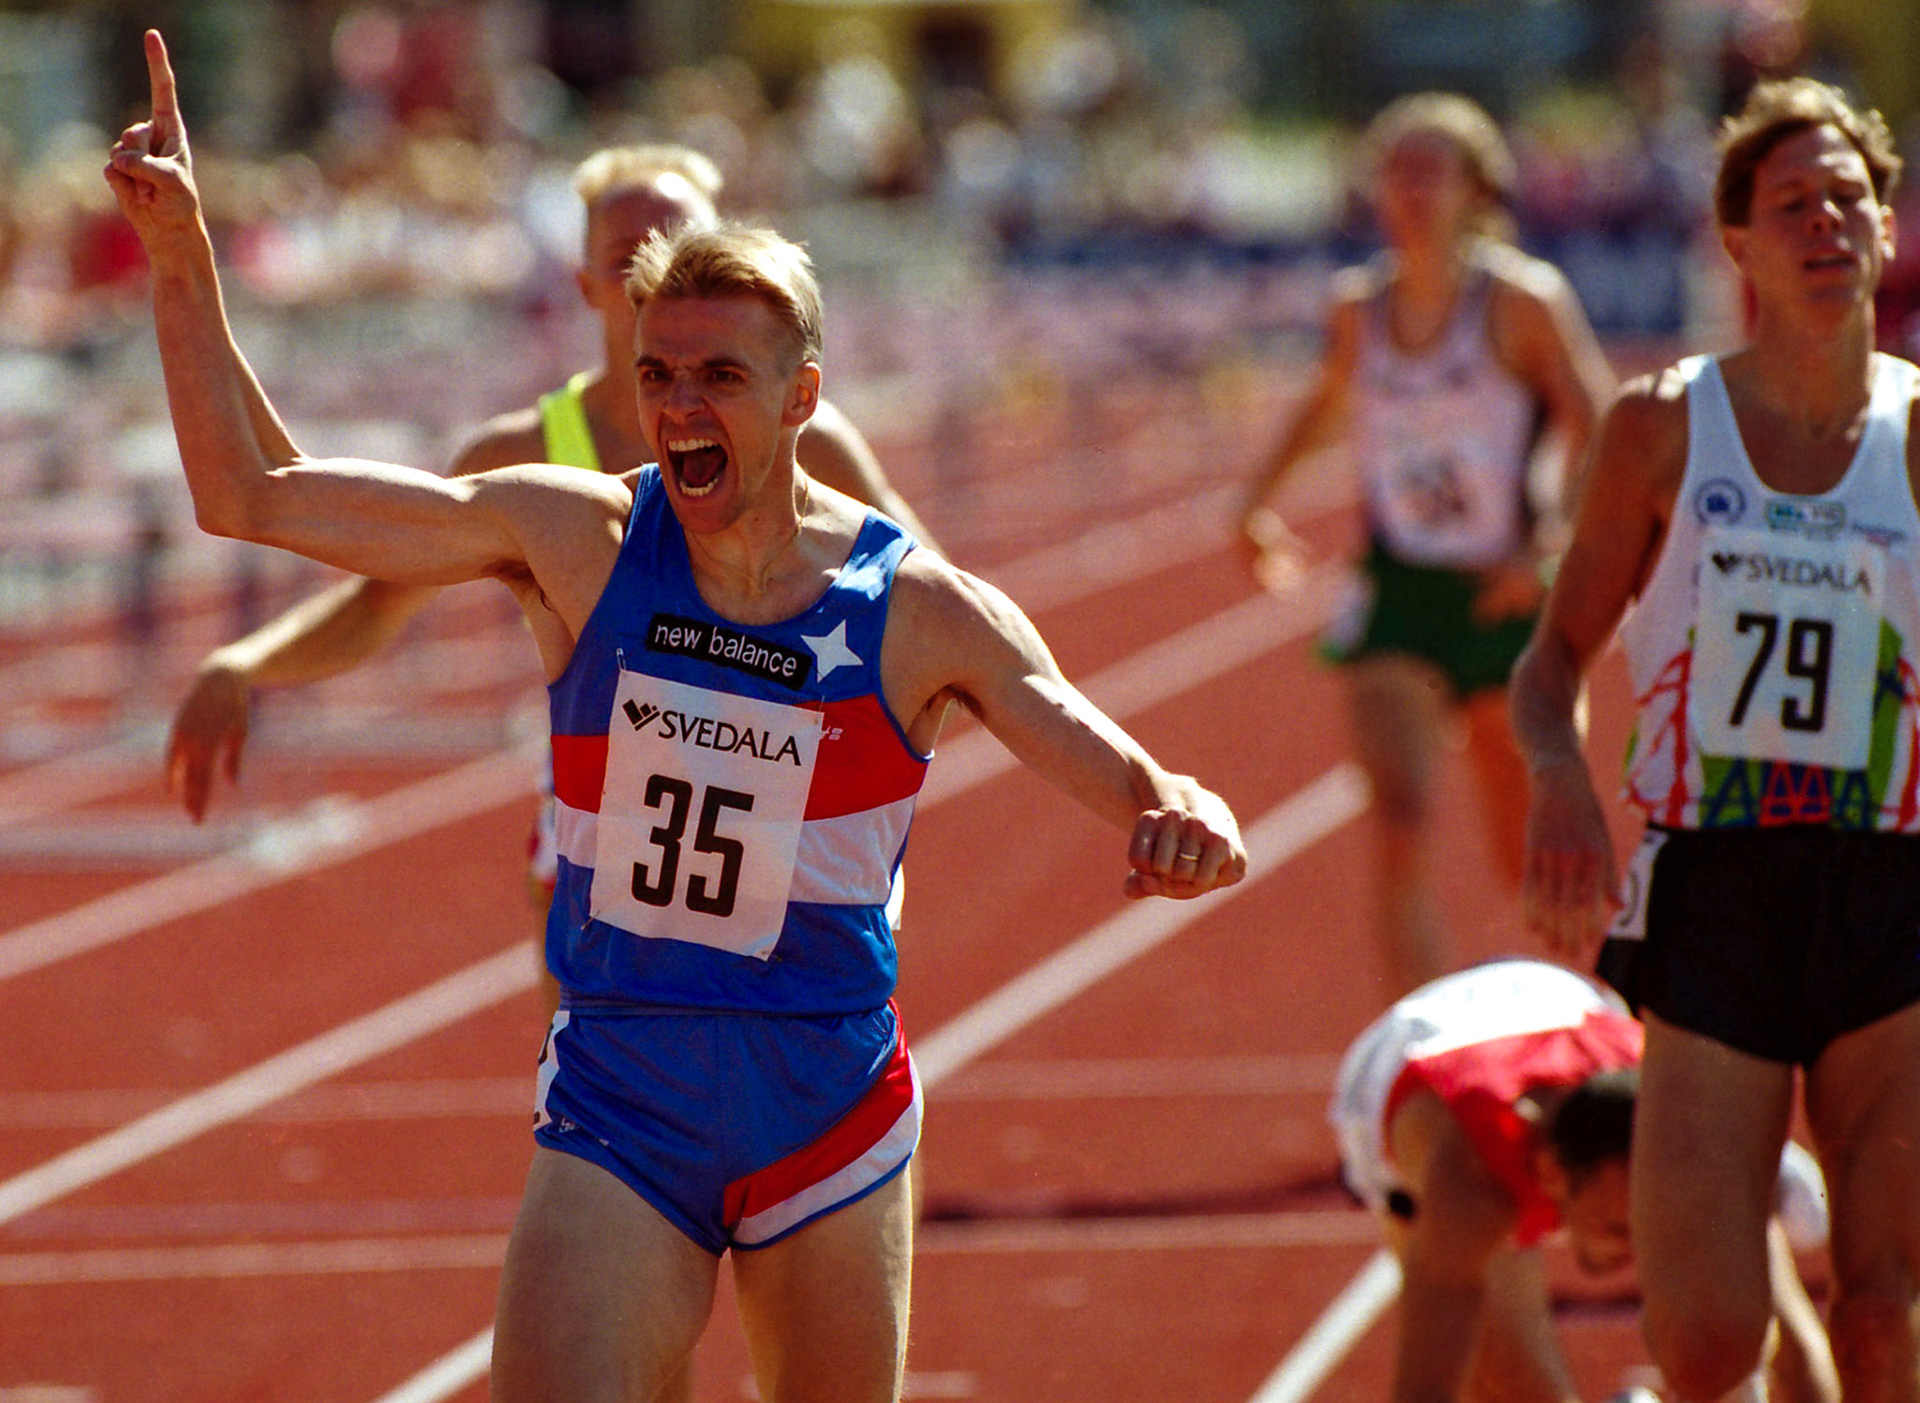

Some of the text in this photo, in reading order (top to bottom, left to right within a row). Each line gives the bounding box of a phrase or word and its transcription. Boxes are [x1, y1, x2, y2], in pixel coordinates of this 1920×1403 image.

[1747, 554, 1871, 595] SVEDALA
[654, 625, 797, 677] new balance
[1729, 611, 1834, 732] 79
[658, 710, 801, 766] SVEDALA
[631, 774, 755, 918] 35
